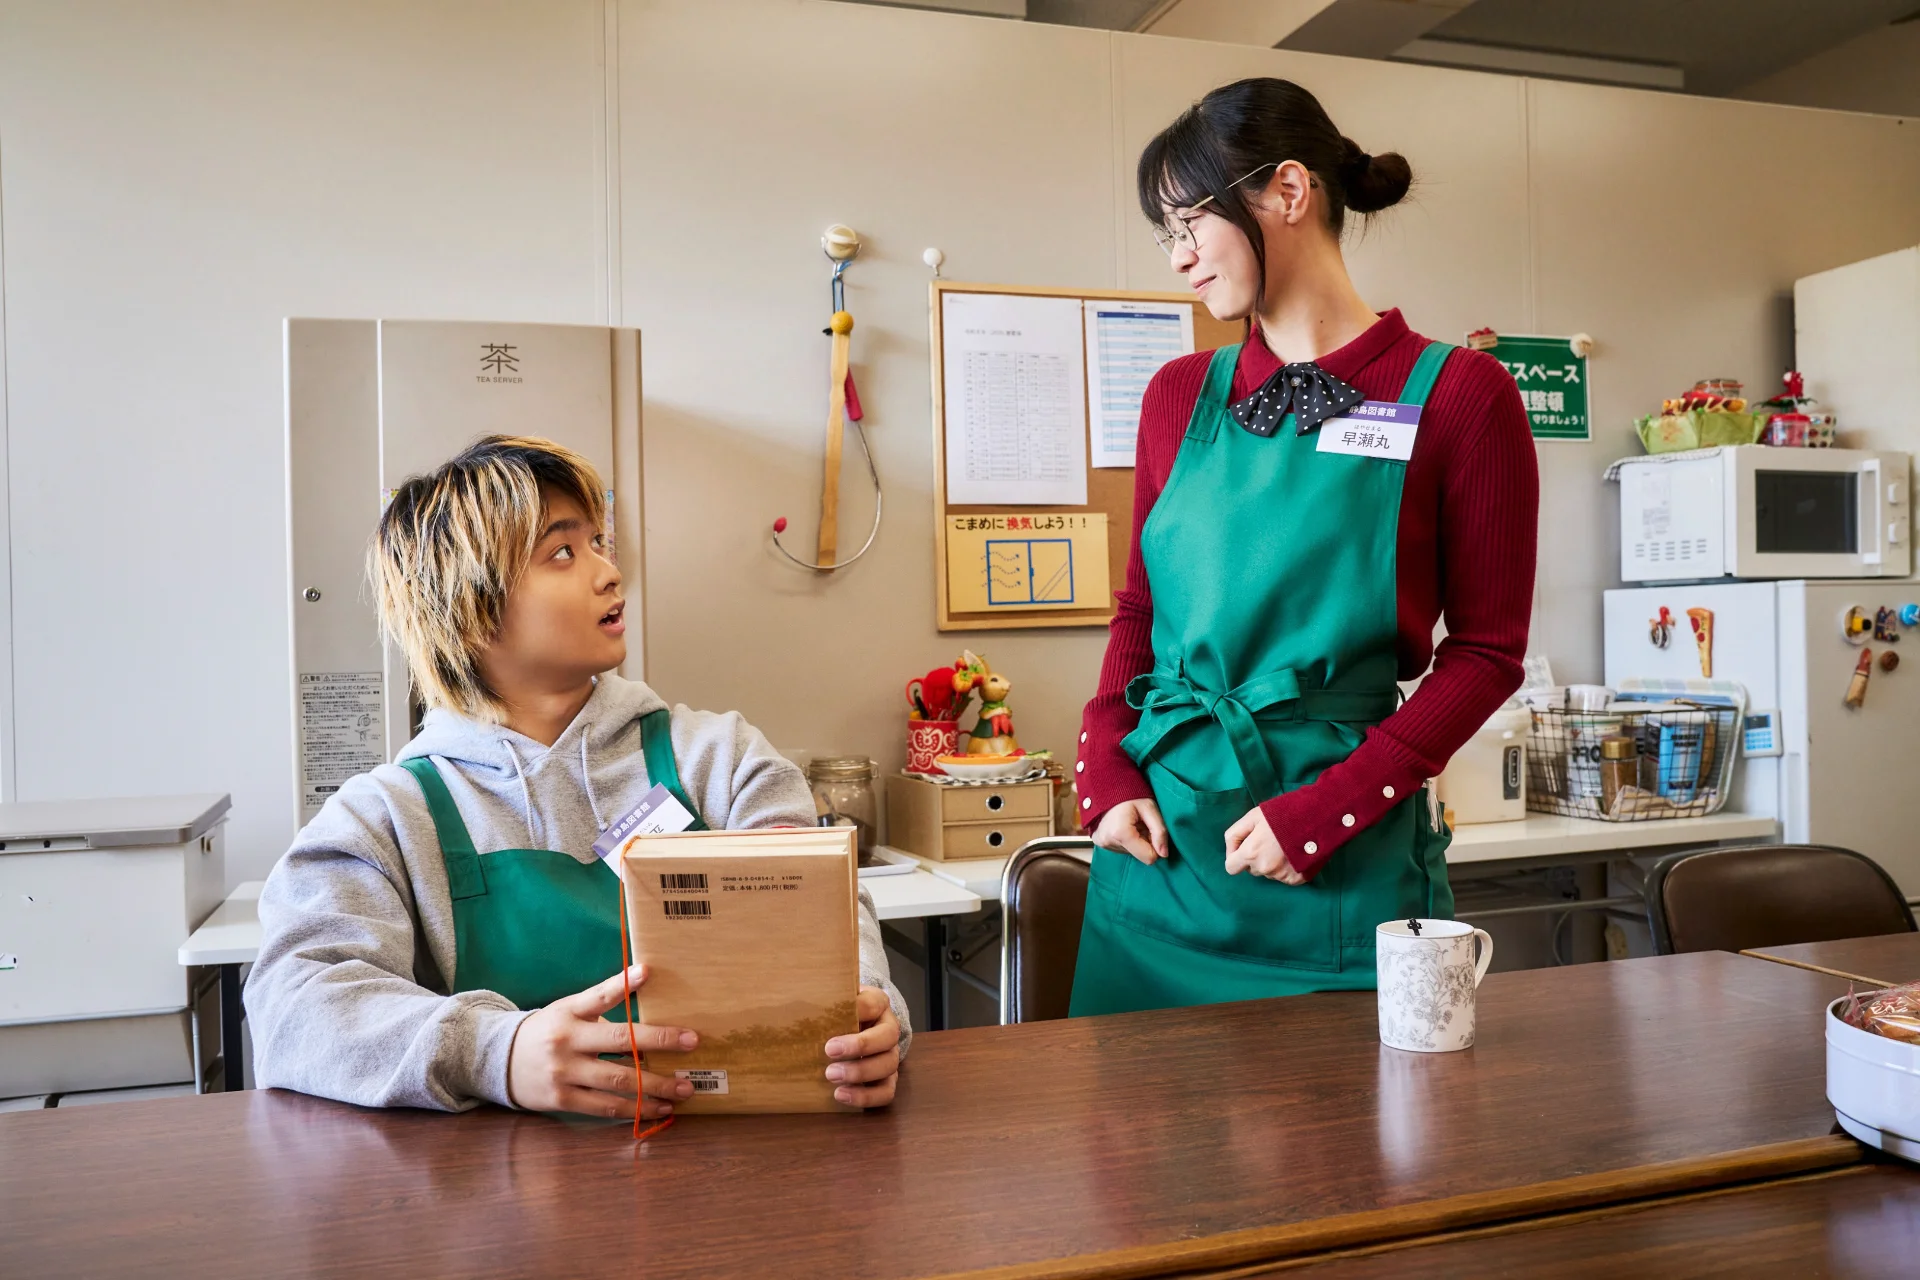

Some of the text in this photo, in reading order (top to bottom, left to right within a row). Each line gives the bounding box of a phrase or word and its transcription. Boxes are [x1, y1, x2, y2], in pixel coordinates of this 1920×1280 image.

[479, 343, 520, 374] 茶
[493, 376, 523, 384] SERVER
[1499, 361, 1580, 383] スペース
[1341, 431, 1390, 450] 早瀬丸
